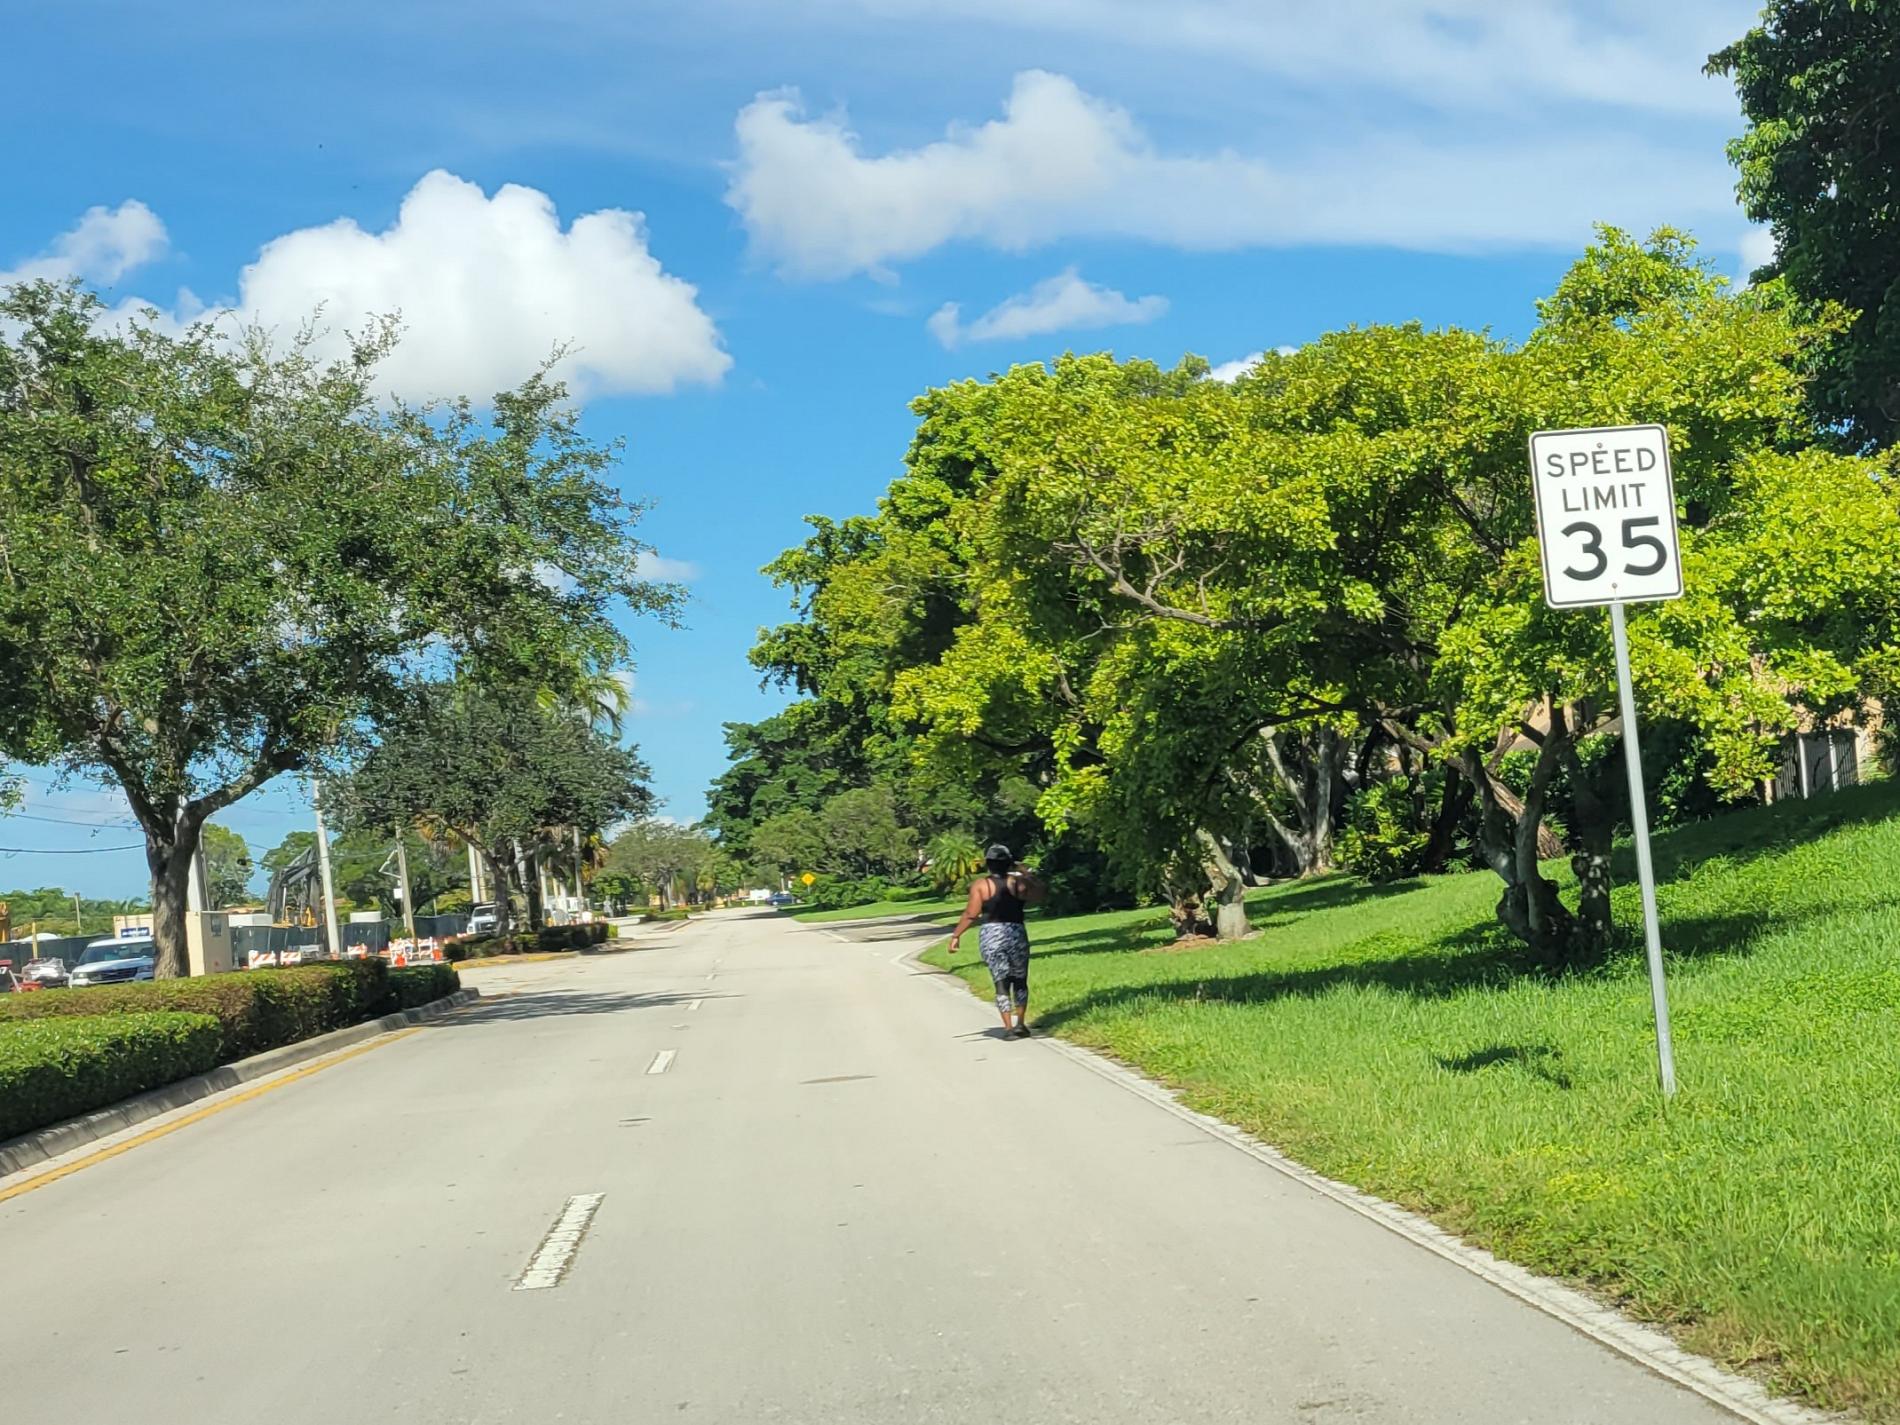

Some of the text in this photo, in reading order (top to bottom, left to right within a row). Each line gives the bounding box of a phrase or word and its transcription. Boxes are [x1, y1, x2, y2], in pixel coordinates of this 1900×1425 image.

[1547, 448, 1656, 478] SPEED
[1562, 483, 1646, 512] LIMIT
[1561, 516, 1668, 581] 35
